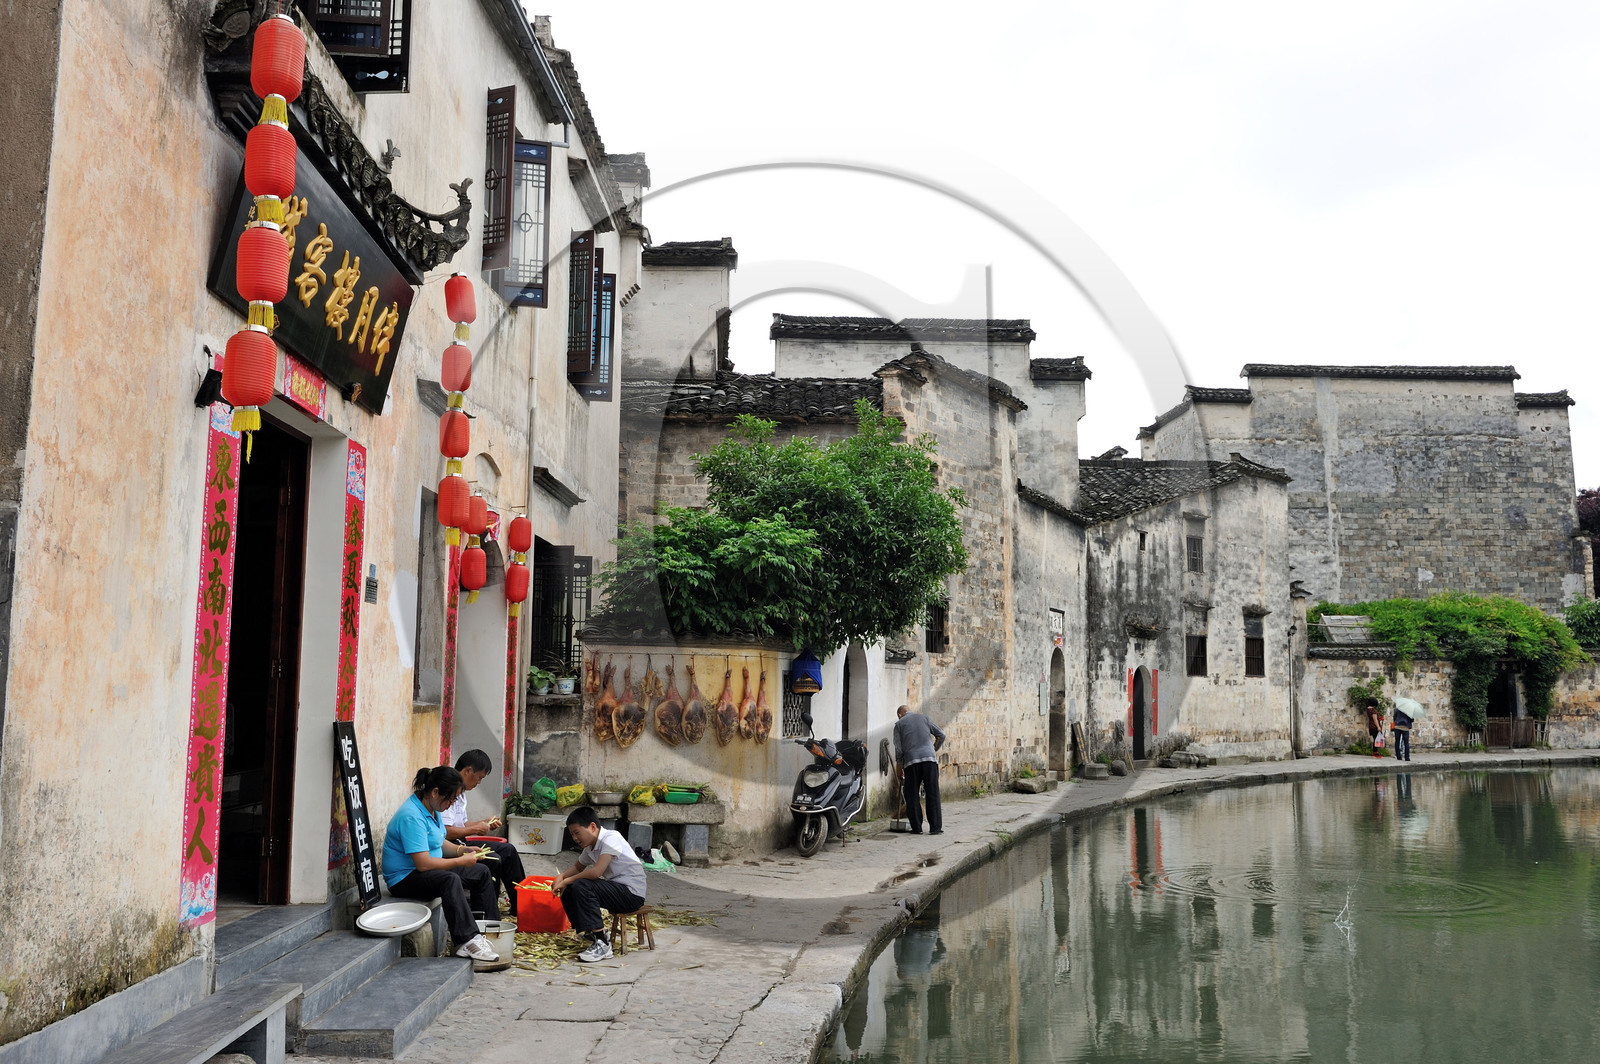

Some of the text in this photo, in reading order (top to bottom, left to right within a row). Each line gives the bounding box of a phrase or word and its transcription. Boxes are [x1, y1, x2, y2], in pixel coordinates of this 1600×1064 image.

[187, 437, 235, 866] 東西南北遇貴人
[341, 735, 375, 893] 吃饭住宿
